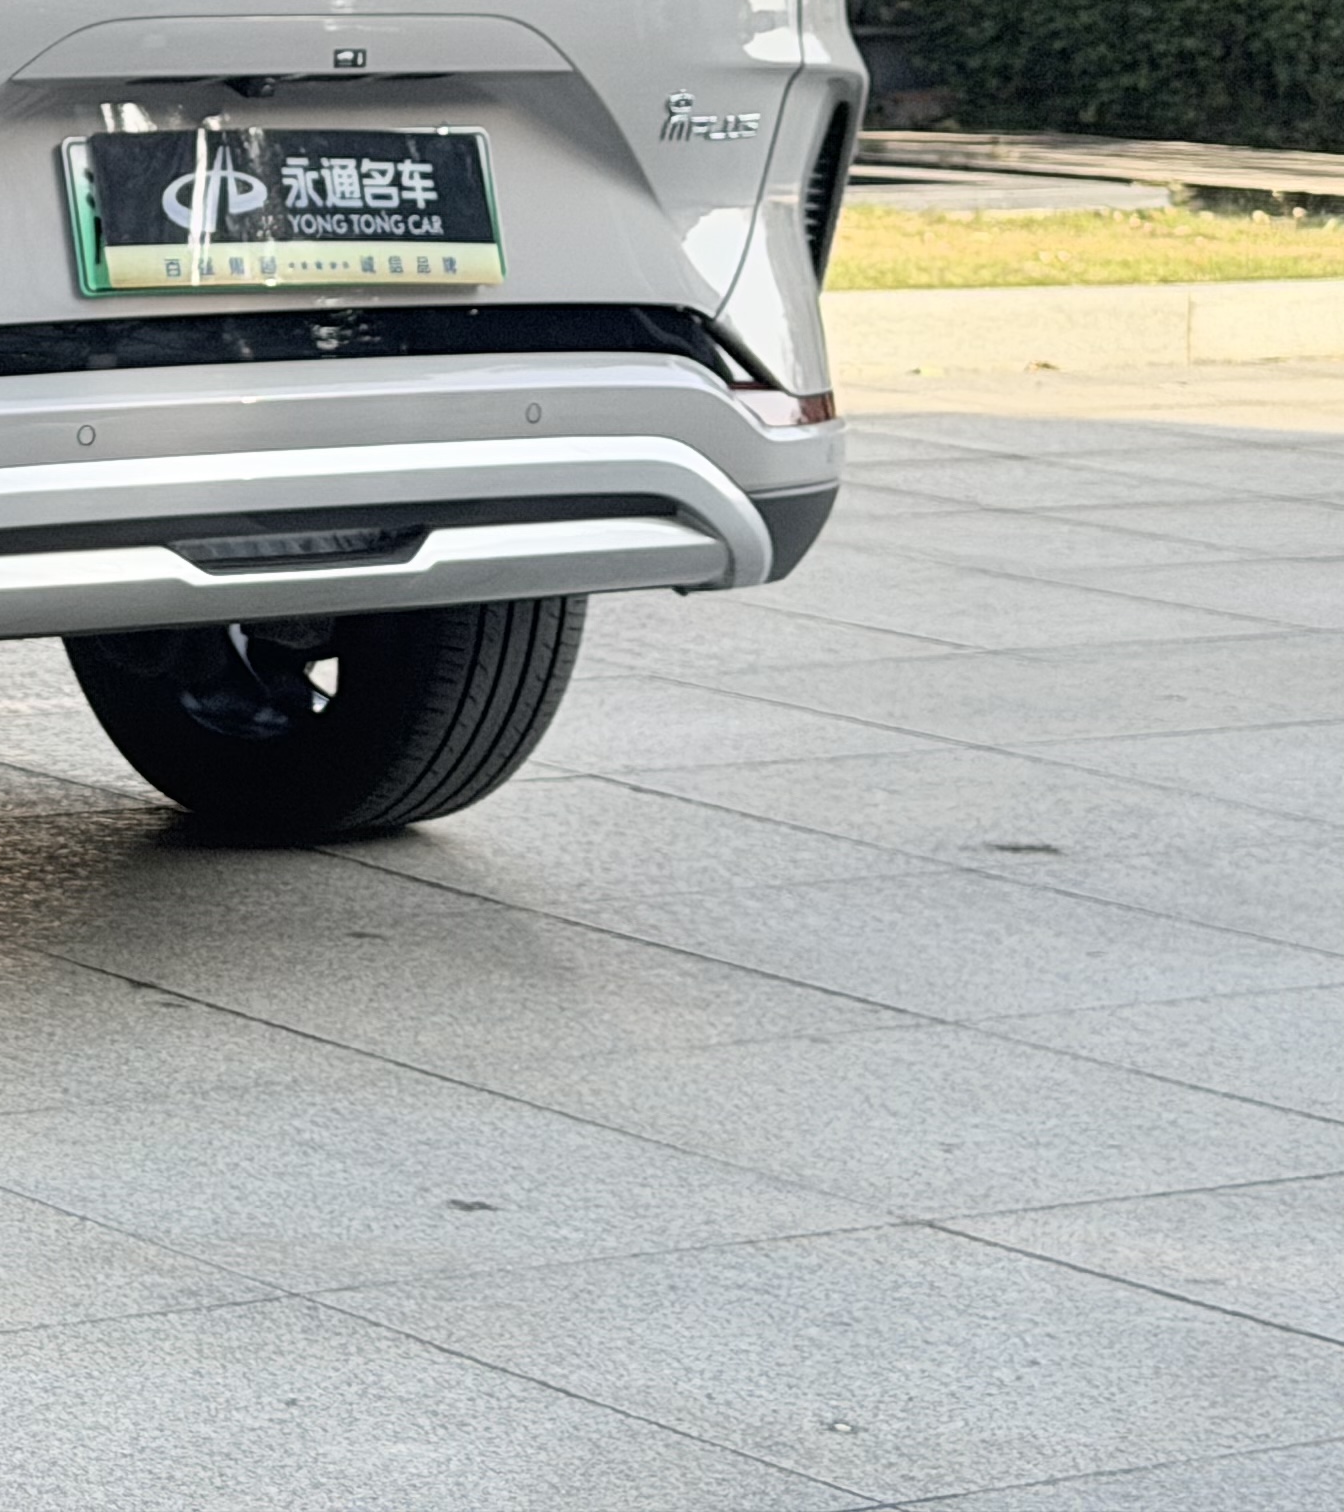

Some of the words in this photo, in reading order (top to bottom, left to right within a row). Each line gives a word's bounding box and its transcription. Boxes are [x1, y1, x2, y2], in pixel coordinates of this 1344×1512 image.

[281, 157, 439, 210] 永通名车
[287, 213, 348, 235] YONG
[349, 210, 406, 235] TONG
[407, 214, 445, 236] CAR
